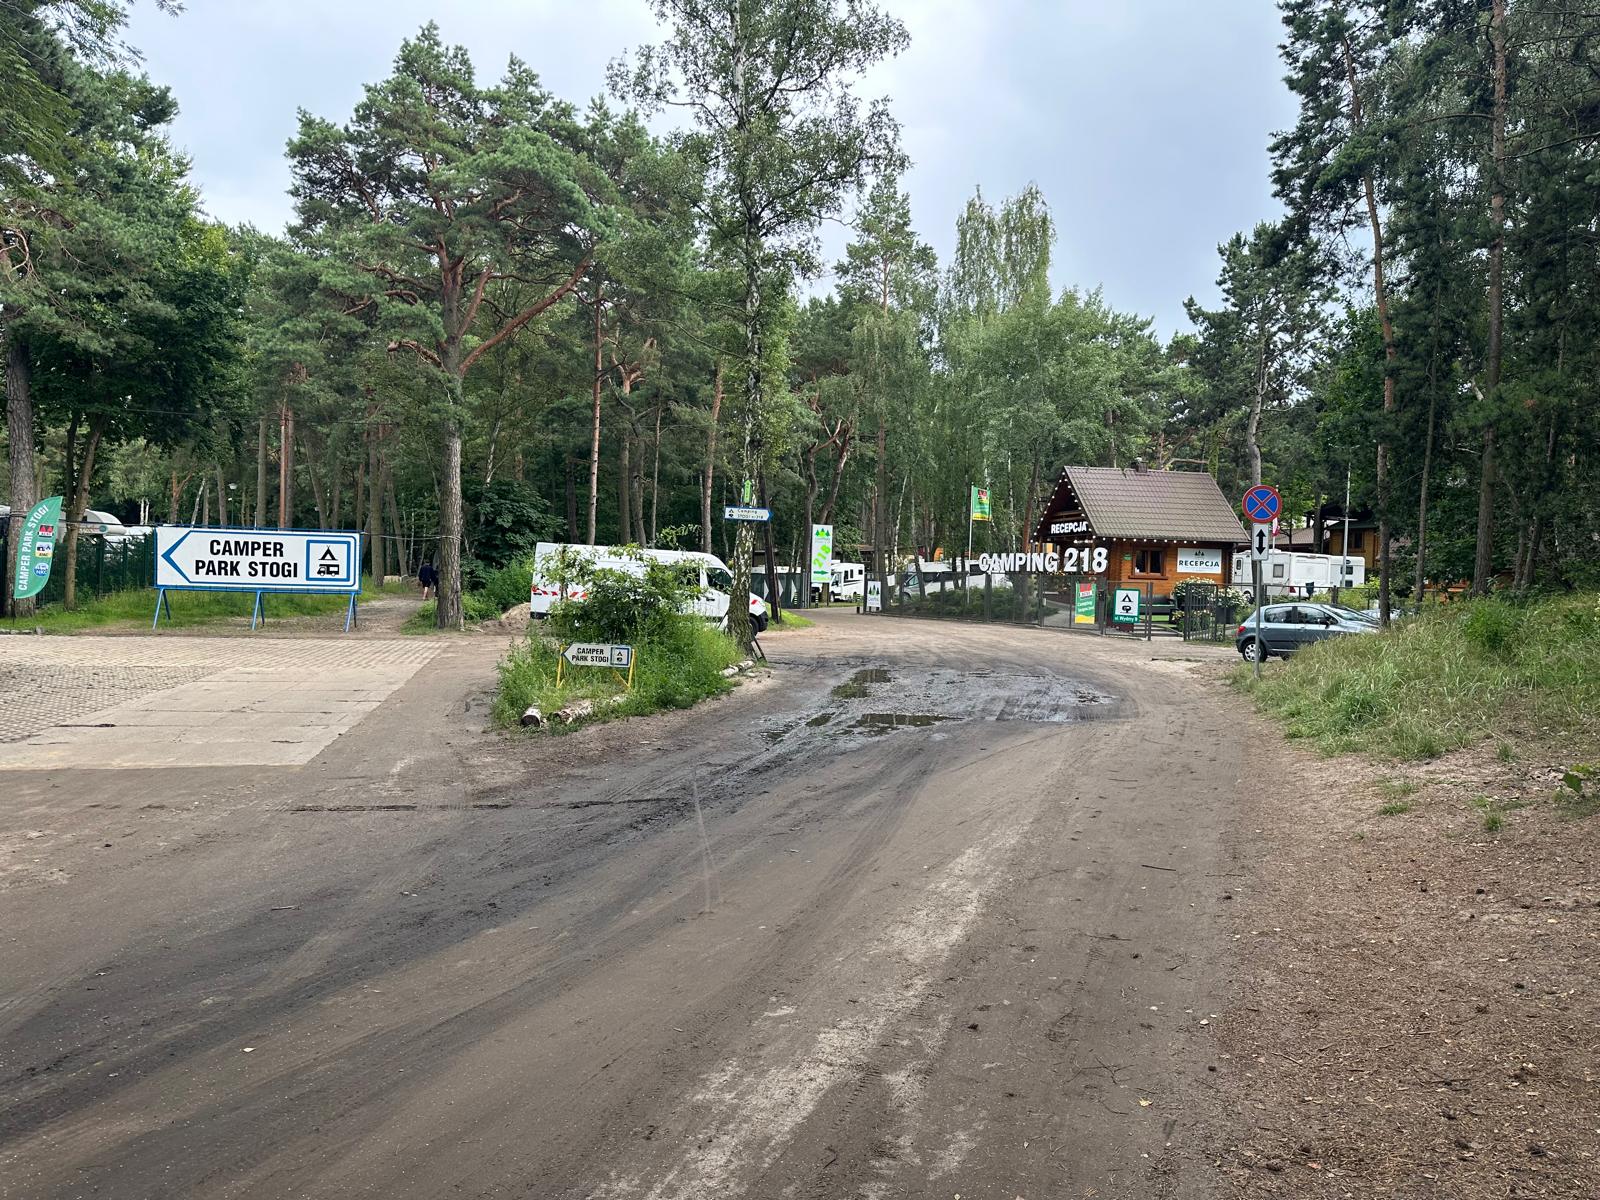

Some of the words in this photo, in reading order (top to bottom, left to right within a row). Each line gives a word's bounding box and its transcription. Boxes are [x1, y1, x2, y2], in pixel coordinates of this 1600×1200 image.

[27, 504, 49, 528] STOGI
[1051, 521, 1088, 534] RECEPCJA
[22, 531, 34, 552] PARK
[209, 539, 284, 558] CAMPER
[813, 544, 831, 568] 218
[978, 552, 1059, 573] CAMPING
[1063, 547, 1108, 573] 218
[1178, 559, 1220, 568] RECEPCJA
[18, 555, 31, 591] CAMPER
[195, 559, 241, 577] PARK
[248, 561, 298, 578] STOGI
